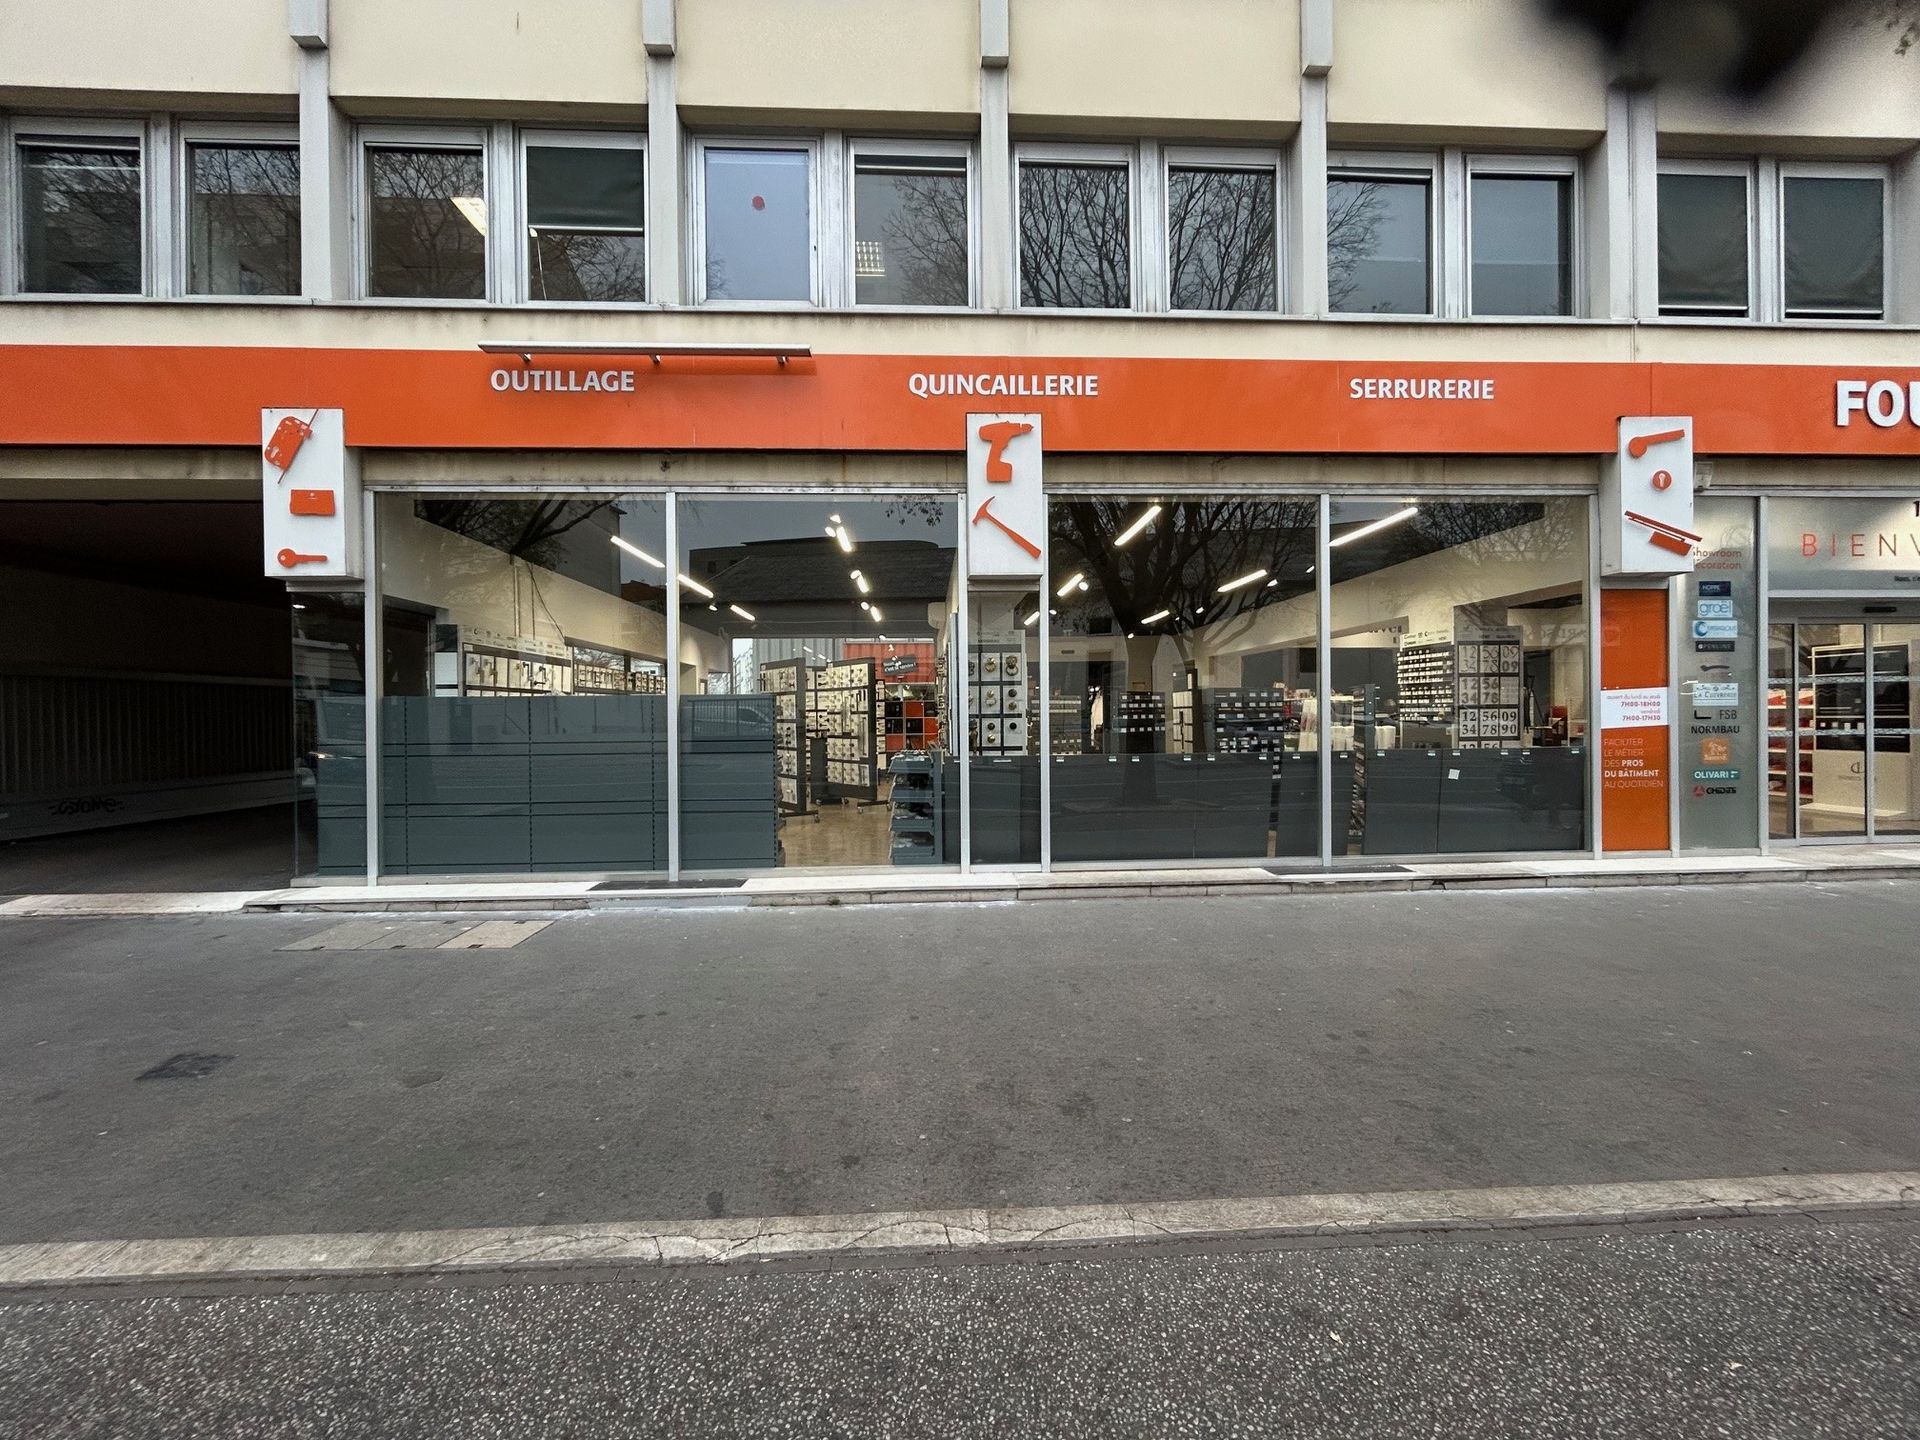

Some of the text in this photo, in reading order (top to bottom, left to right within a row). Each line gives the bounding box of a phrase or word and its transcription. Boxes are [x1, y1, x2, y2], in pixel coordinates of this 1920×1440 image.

[490, 369, 635, 392] OUTILLAGE
[908, 373, 1099, 398] QUINCAILLERIE
[1350, 378, 1494, 399] SERRURERIE
[1693, 559, 1742, 569] écoration
[1463, 711, 1477, 721] 12
[1482, 711, 1498, 721] 56
[1502, 711, 1517, 721] 09
[1719, 710, 1737, 719] FSB
[1462, 725, 1476, 734] 34
[1482, 725, 1497, 734] 78
[1501, 724, 1517, 734] 90
[1691, 726, 1740, 734] NORMBAU
[1604, 738, 1643, 746] FACILITER
[1621, 759, 1644, 767] PROS
[1618, 767, 1659, 777] BÂTIMENT
[1618, 780, 1664, 788] QUOTIDIEN
